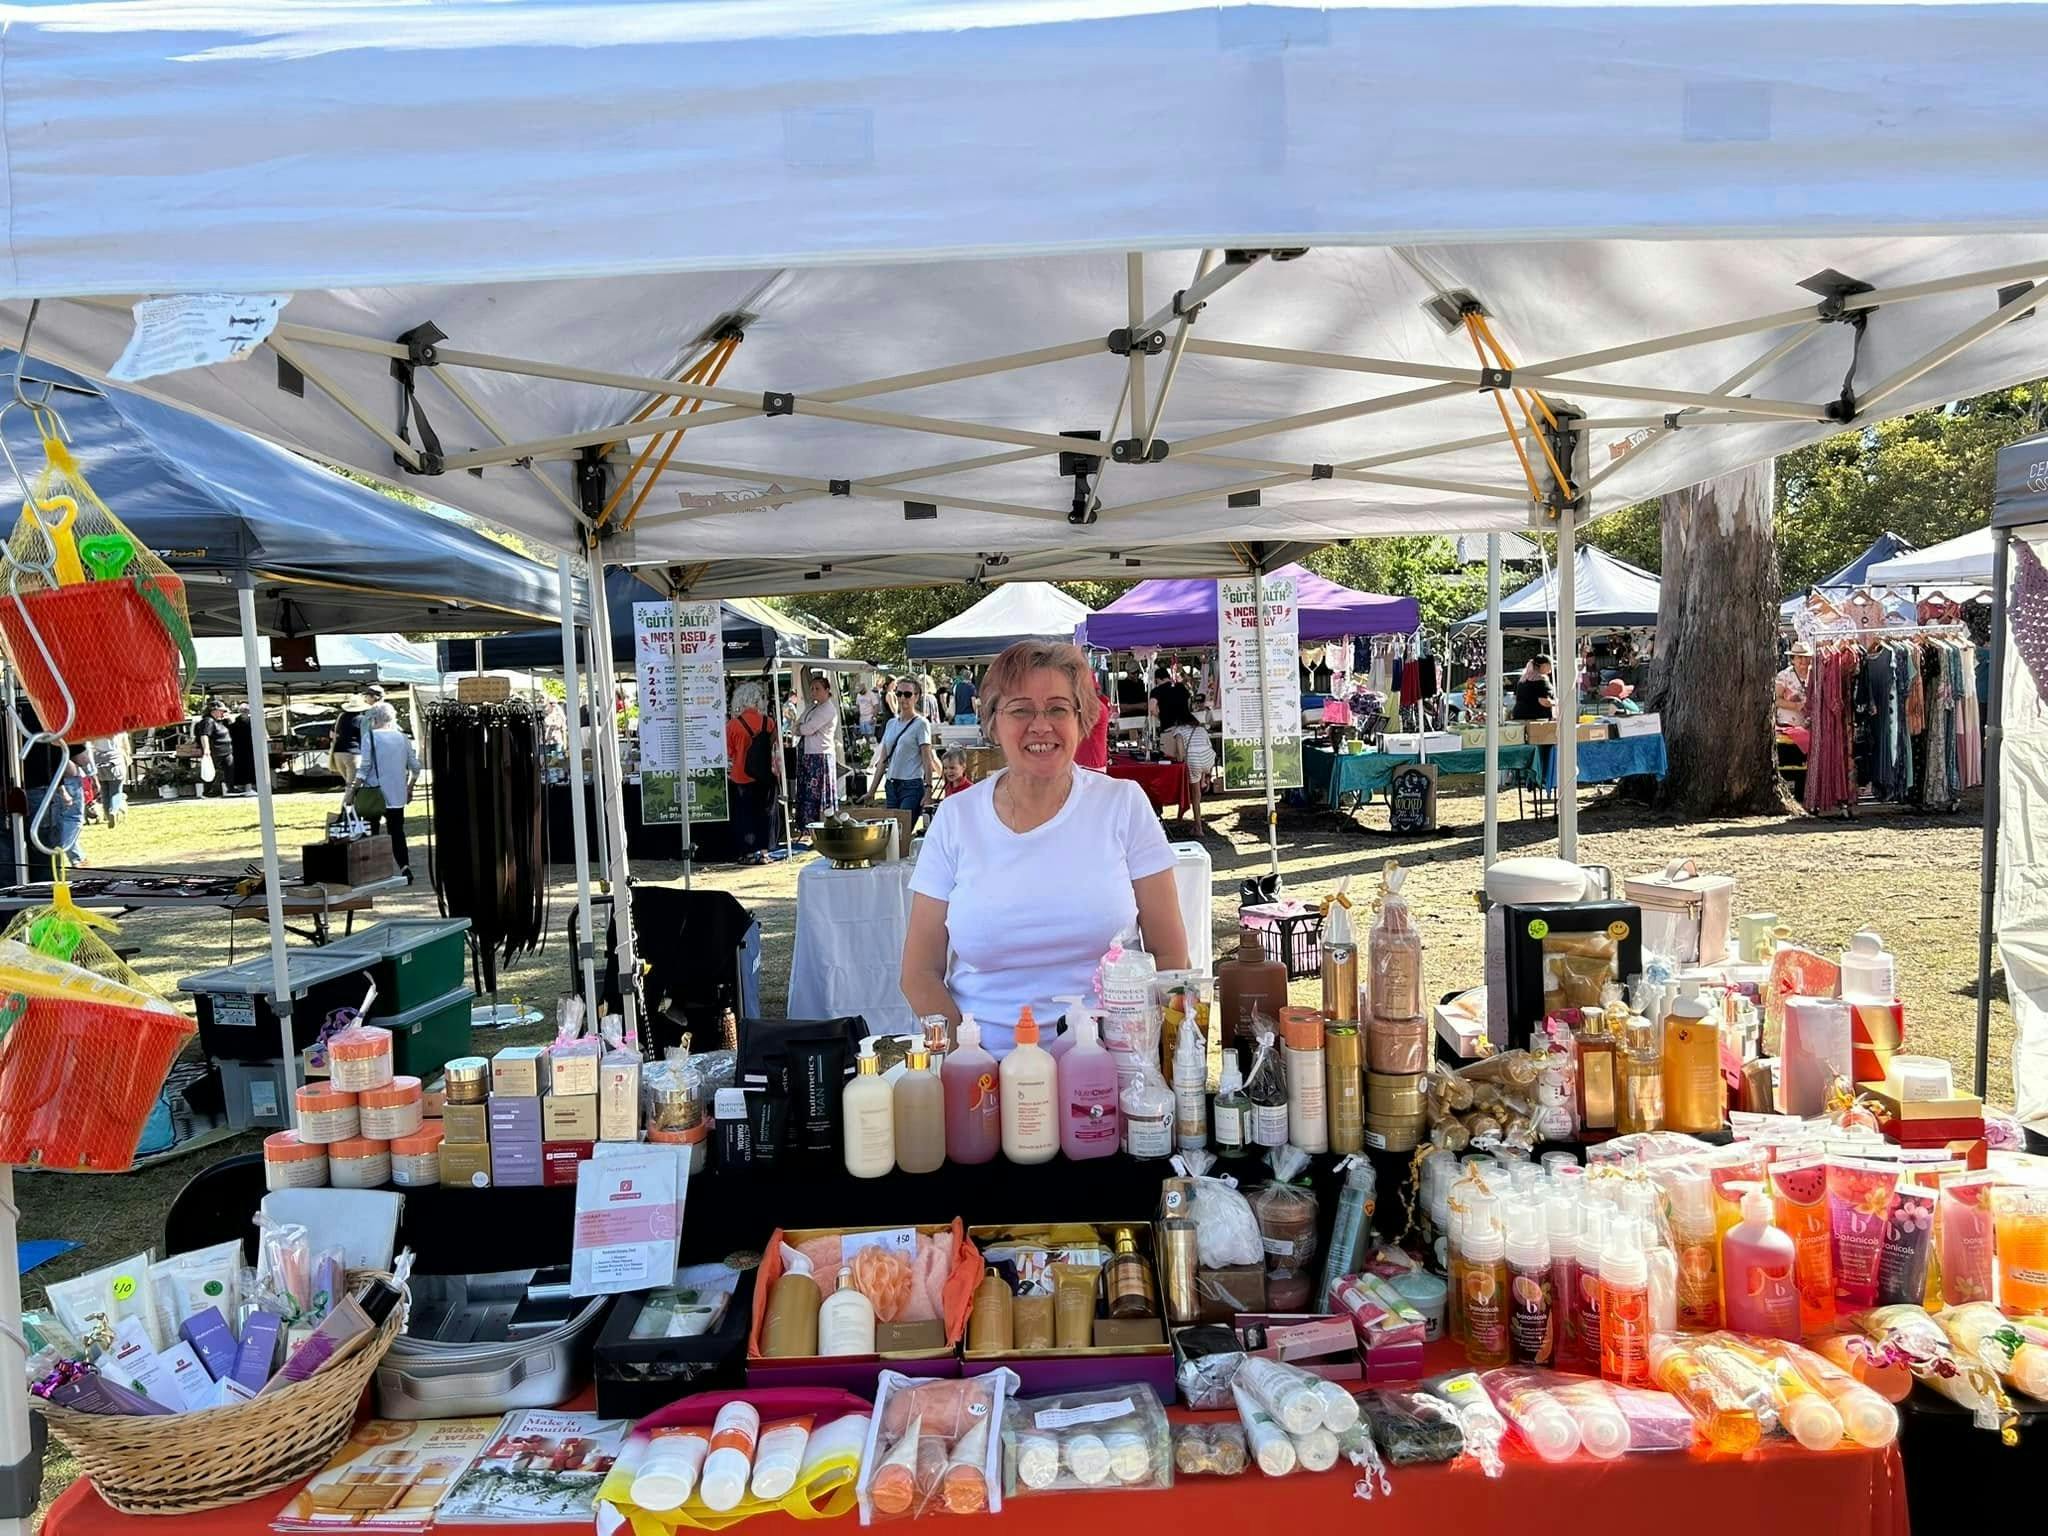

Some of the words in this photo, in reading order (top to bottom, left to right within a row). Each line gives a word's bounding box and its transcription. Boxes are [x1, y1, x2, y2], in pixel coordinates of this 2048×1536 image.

[1229, 592, 1250, 604] GUT
[646, 616, 669, 629] GUT
[1241, 617, 1276, 628] ENEGY
[650, 631, 707, 643] INCRASED
[1229, 640, 1236, 648] 7
[1229, 650, 1236, 658] 2
[648, 678, 656, 686] 2
[649, 699, 656, 707] 7
[808, 1055, 816, 1117] nutrimetics
[816, 1087, 825, 1116] MAN
[1807, 1214, 1821, 1232] b
[1851, 1213, 1868, 1234] b
[1886, 1221, 1901, 1241] b
[1834, 1232, 1879, 1245] botanicals
[1883, 1243, 1915, 1255] anicals
[1774, 1282, 1786, 1297] b
[1477, 1290, 1489, 1306] b
[1526, 1298, 1538, 1314] b
[526, 1418, 563, 1426] Make
[566, 1418, 577, 1426] it
[435, 1426, 485, 1434] Make
[521, 1425, 583, 1434] beautiful
[441, 1433, 486, 1441] wish
